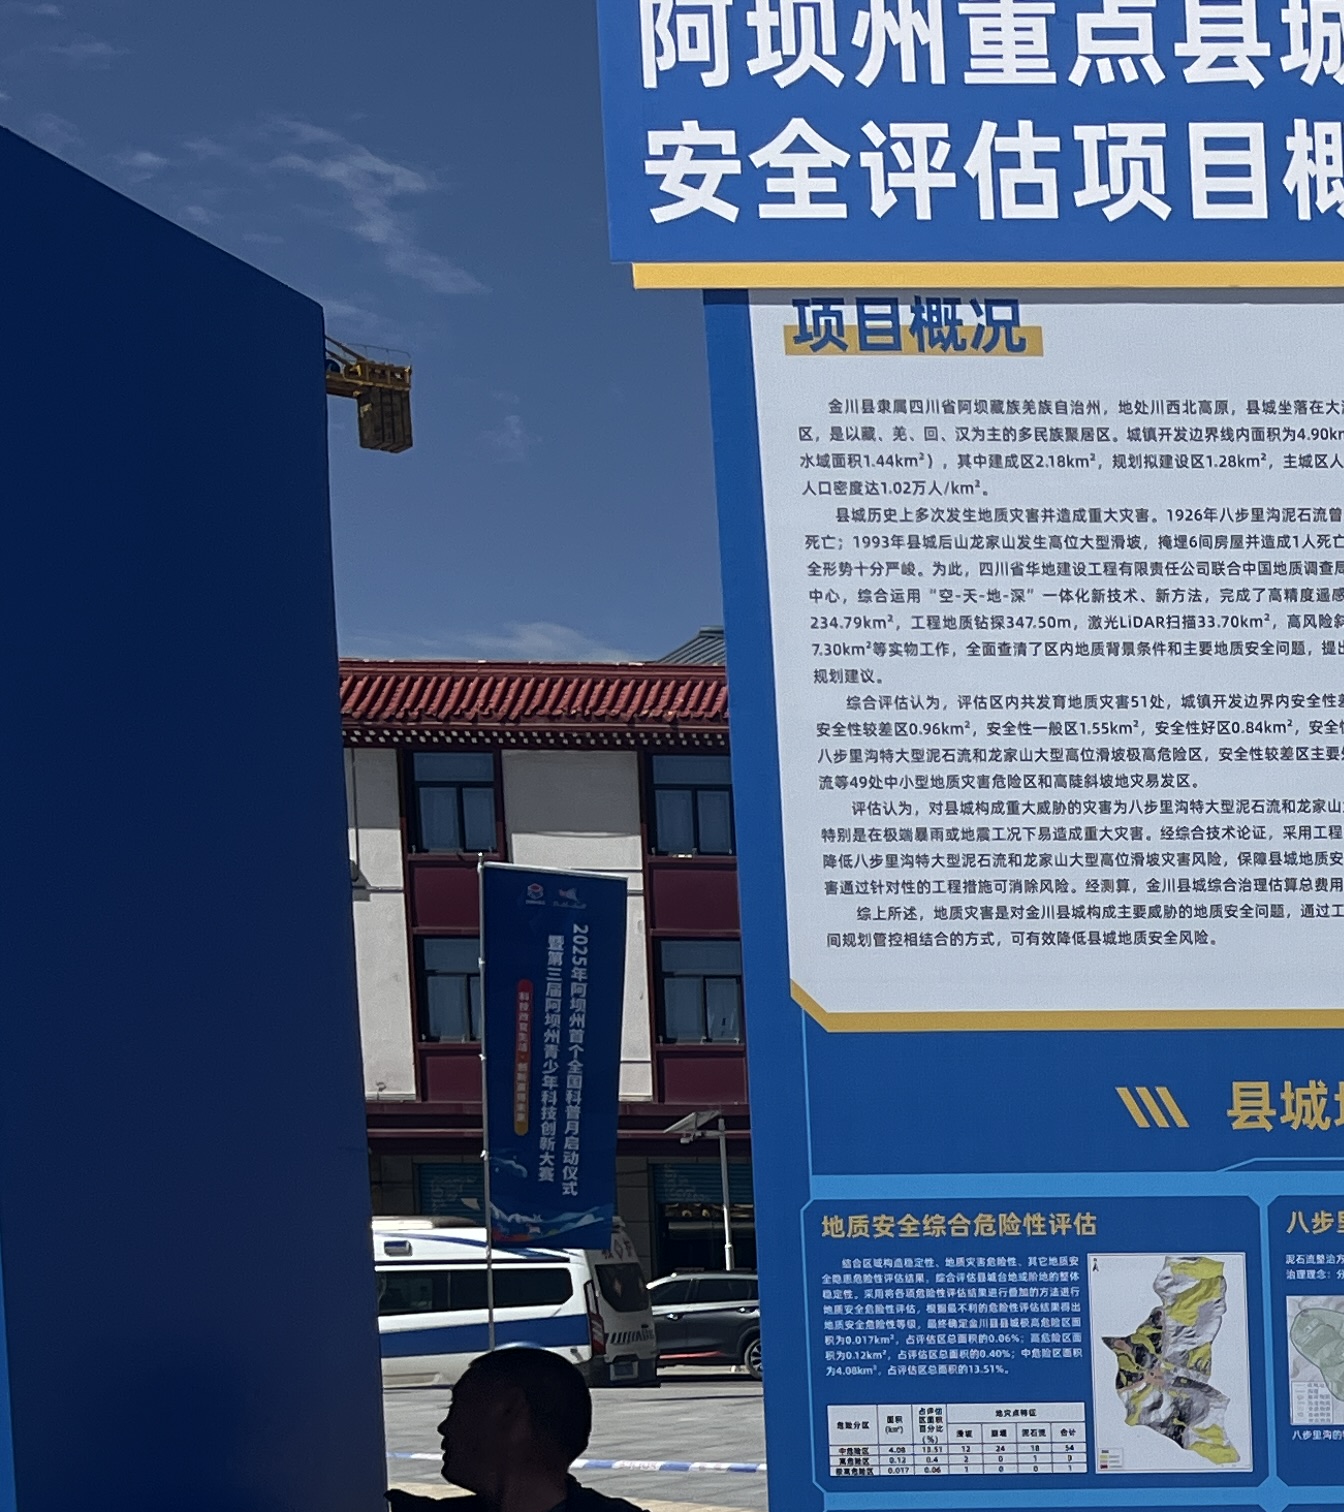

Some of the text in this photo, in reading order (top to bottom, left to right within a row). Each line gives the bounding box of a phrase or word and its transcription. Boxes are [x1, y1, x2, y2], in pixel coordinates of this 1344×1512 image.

[791, 297, 1028, 354] 项目概况
[801, 479, 989, 497] 人口密度达1.02万人/km²。
[813, 668, 883, 685] 规划建议。
[820, 1212, 1098, 1239] 地质安全综合危险性评估
